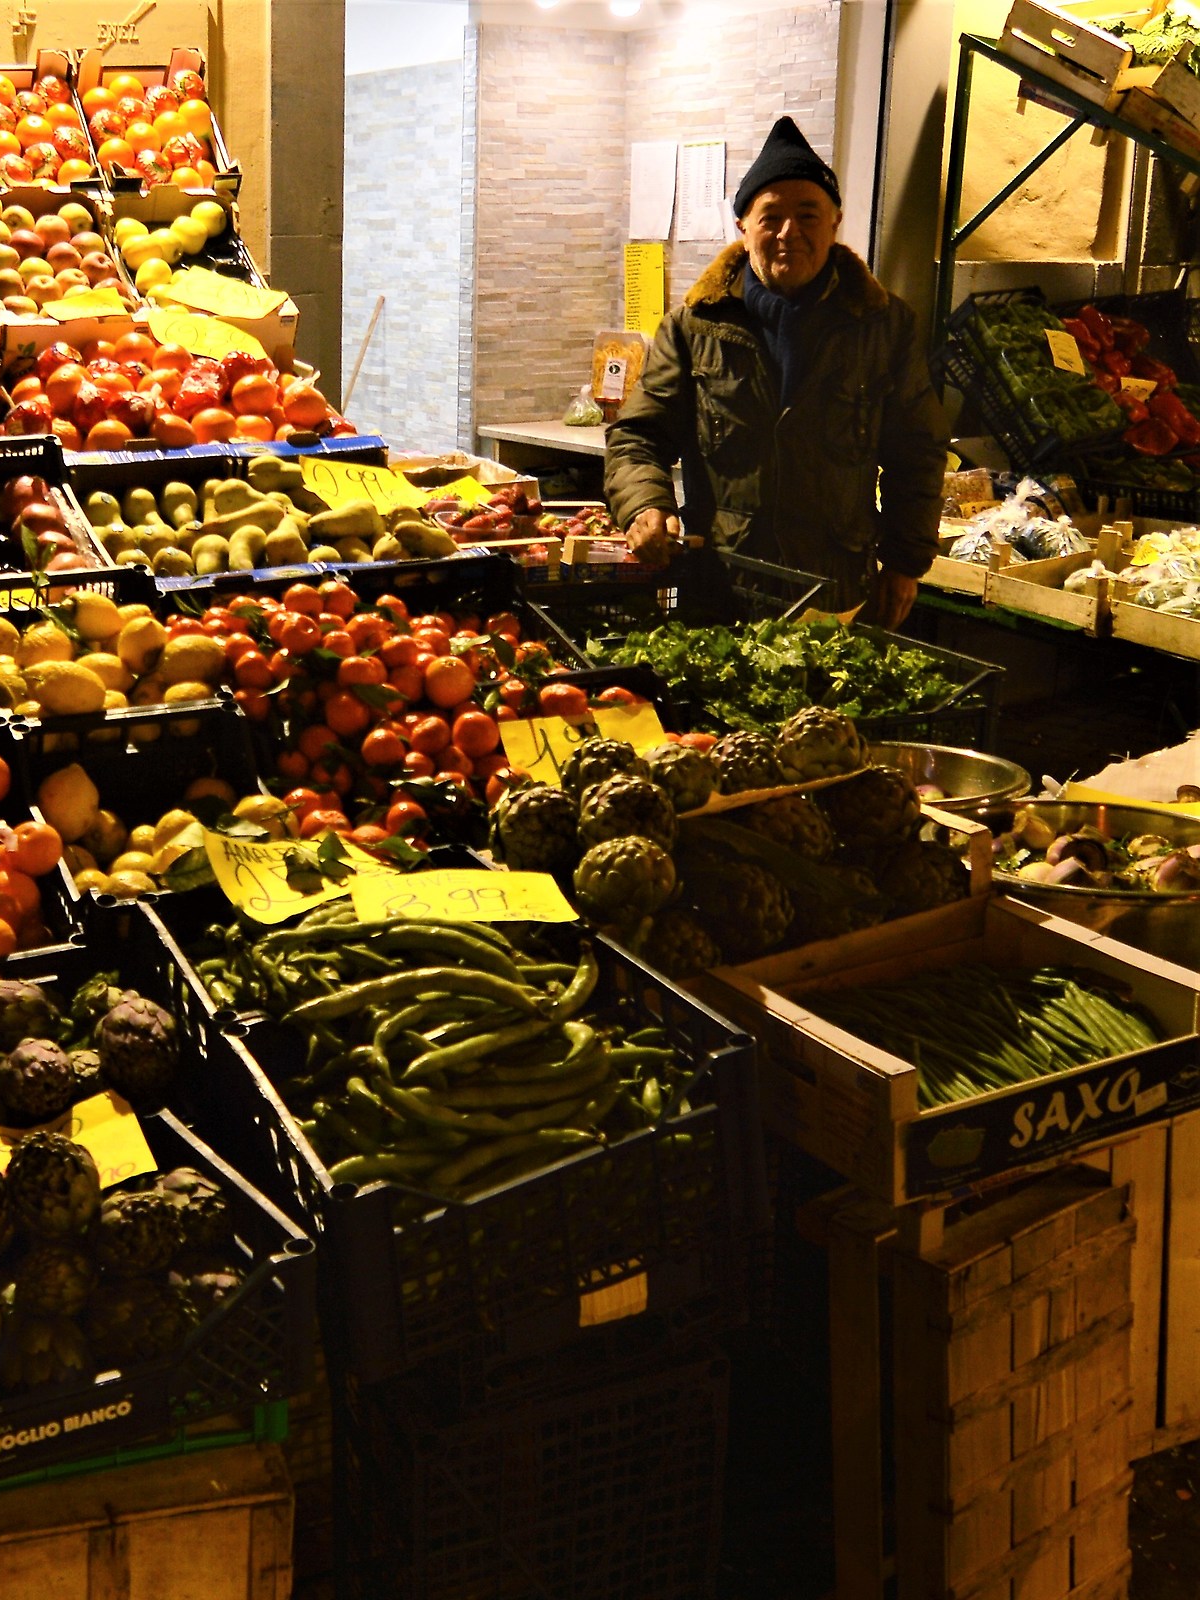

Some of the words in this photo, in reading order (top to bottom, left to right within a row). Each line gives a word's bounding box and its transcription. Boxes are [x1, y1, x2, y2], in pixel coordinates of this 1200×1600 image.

[97, 22, 140, 44] ENEL
[1009, 1067, 1142, 1149] SAXO
[63, 1400, 132, 1433] BIANCO
